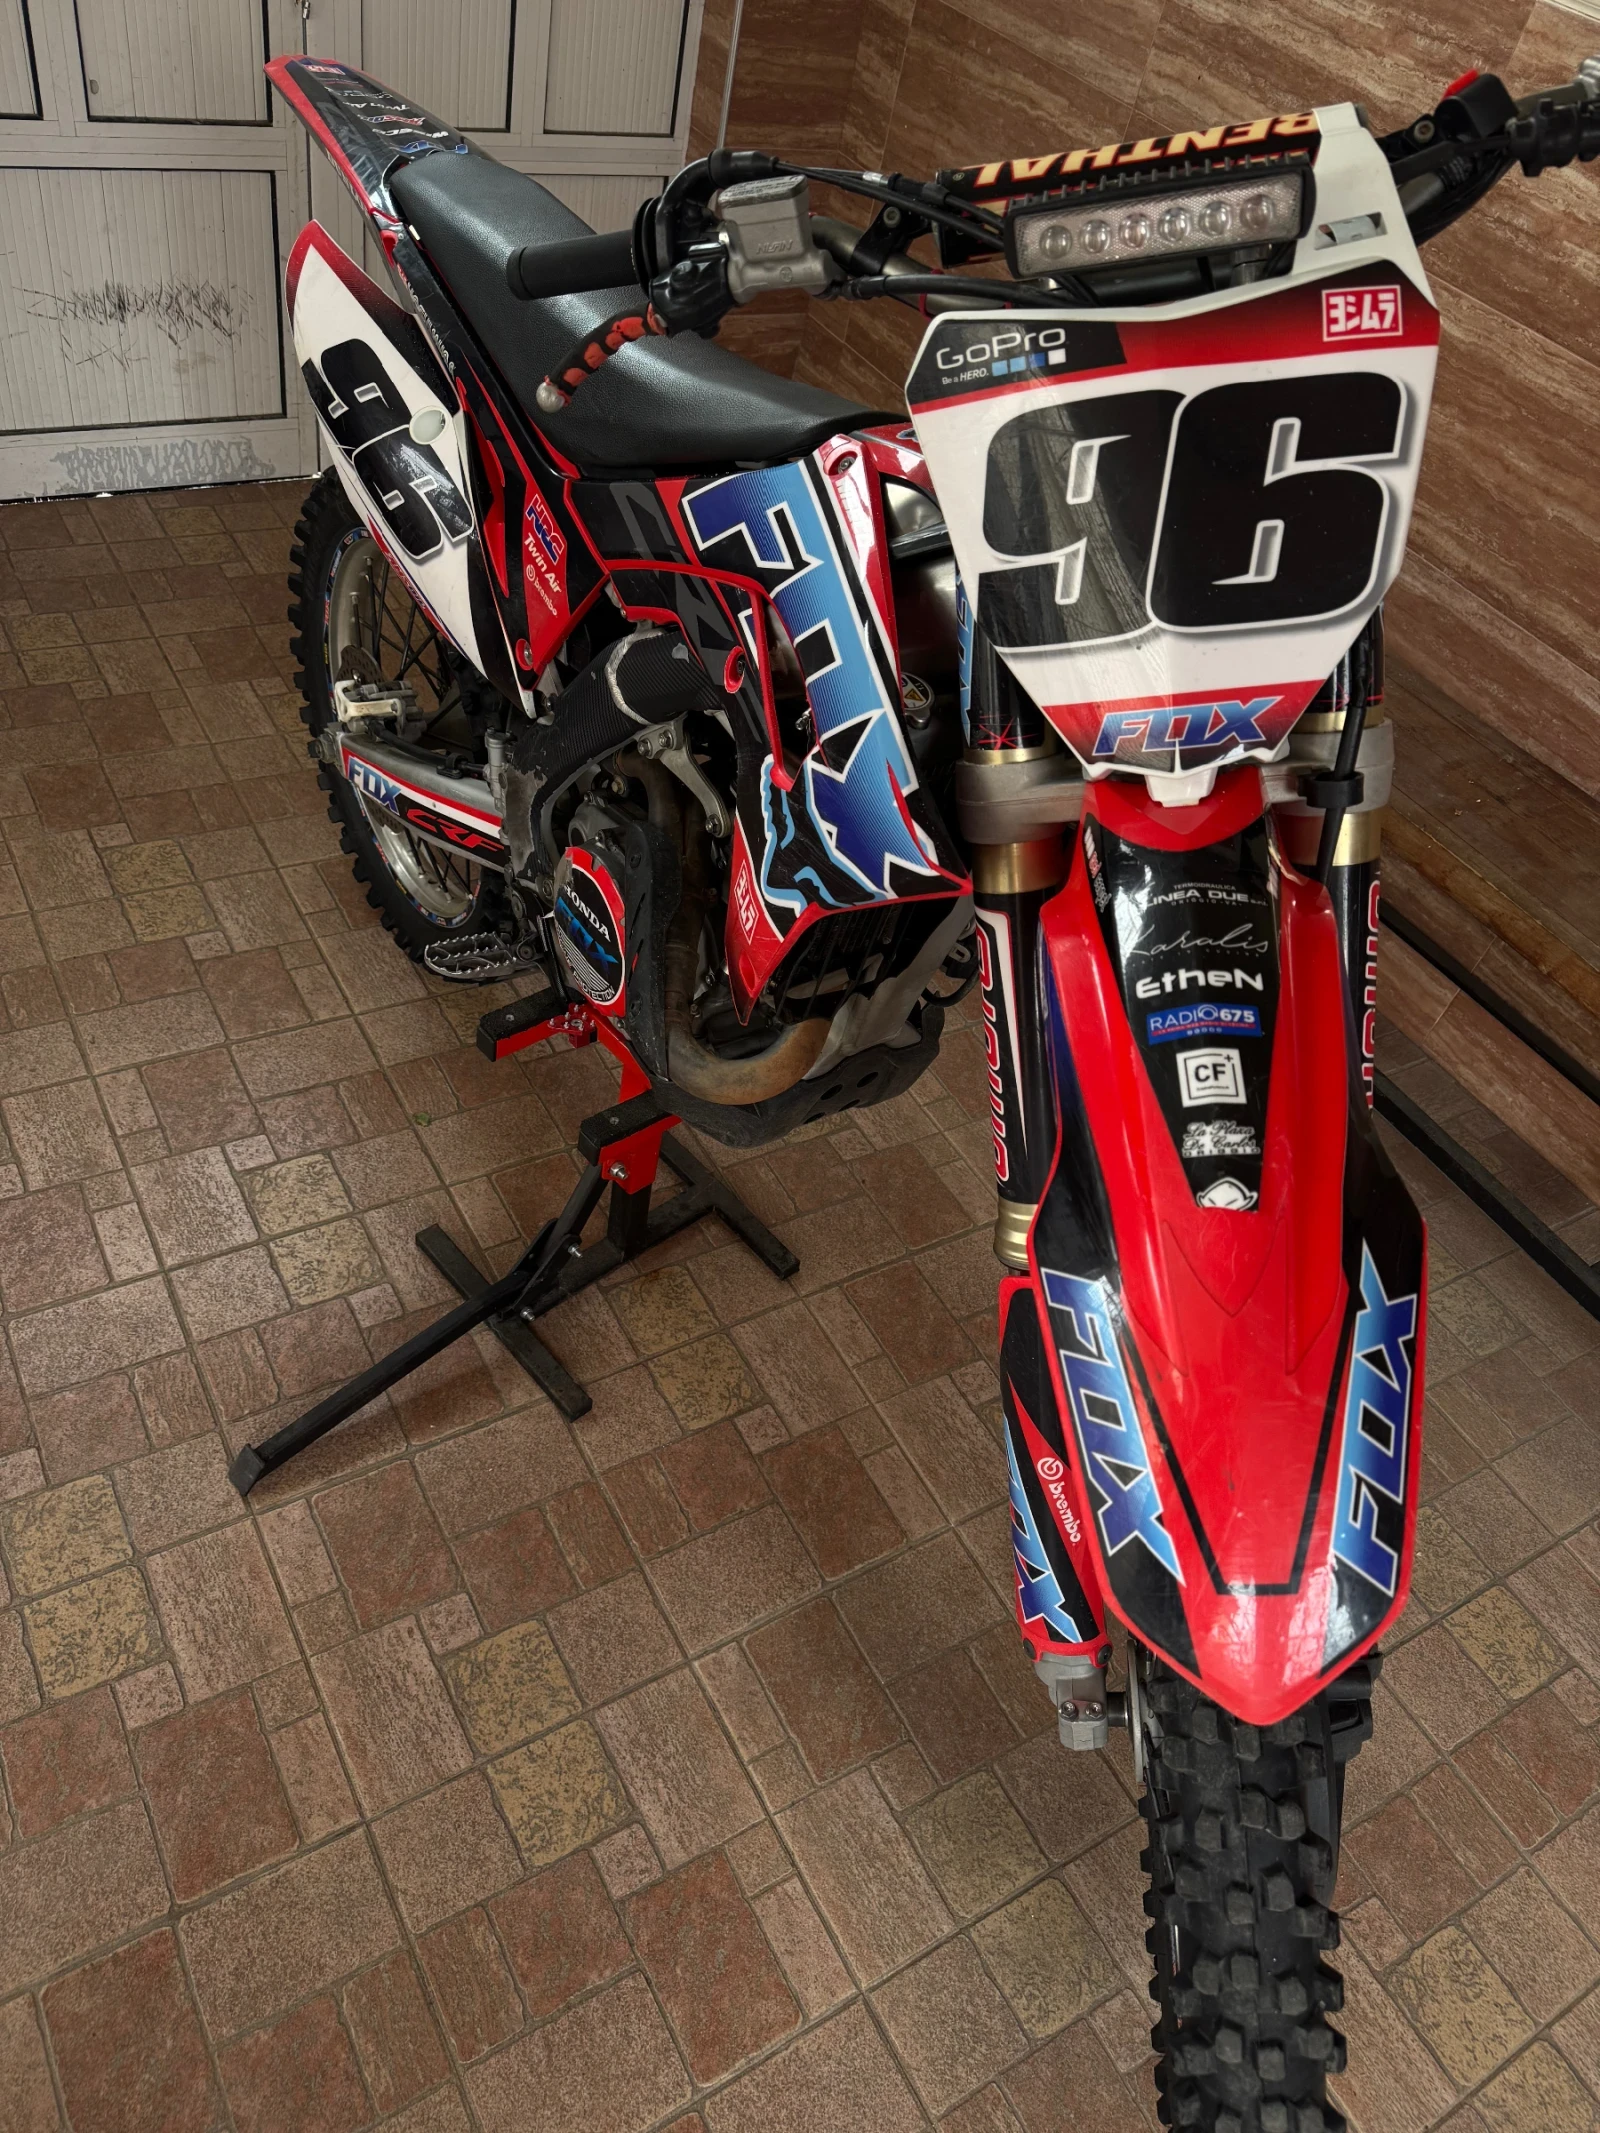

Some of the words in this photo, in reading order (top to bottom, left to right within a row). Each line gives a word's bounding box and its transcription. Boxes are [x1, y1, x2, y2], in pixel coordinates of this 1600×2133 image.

[936, 328, 1066, 370] GoPro
[942, 377, 953, 385] Be
[525, 493, 565, 566] HRC
[978, 371, 1408, 653] 96
[524, 532, 548, 573] Twin
[545, 572, 562, 593] Air
[533, 576, 558, 617] brembo
[1092, 696, 1286, 756] FOX
[348, 756, 403, 816] FOX
[406, 808, 505, 852] CRF
[1173, 882, 1236, 891] TERMOIDRAULICA
[1207, 889, 1248, 903] DUE
[1040, 1267, 1187, 1588] FOX
[1329, 1236, 1418, 1598] FOX
[1047, 1480, 1081, 1544] brembo
